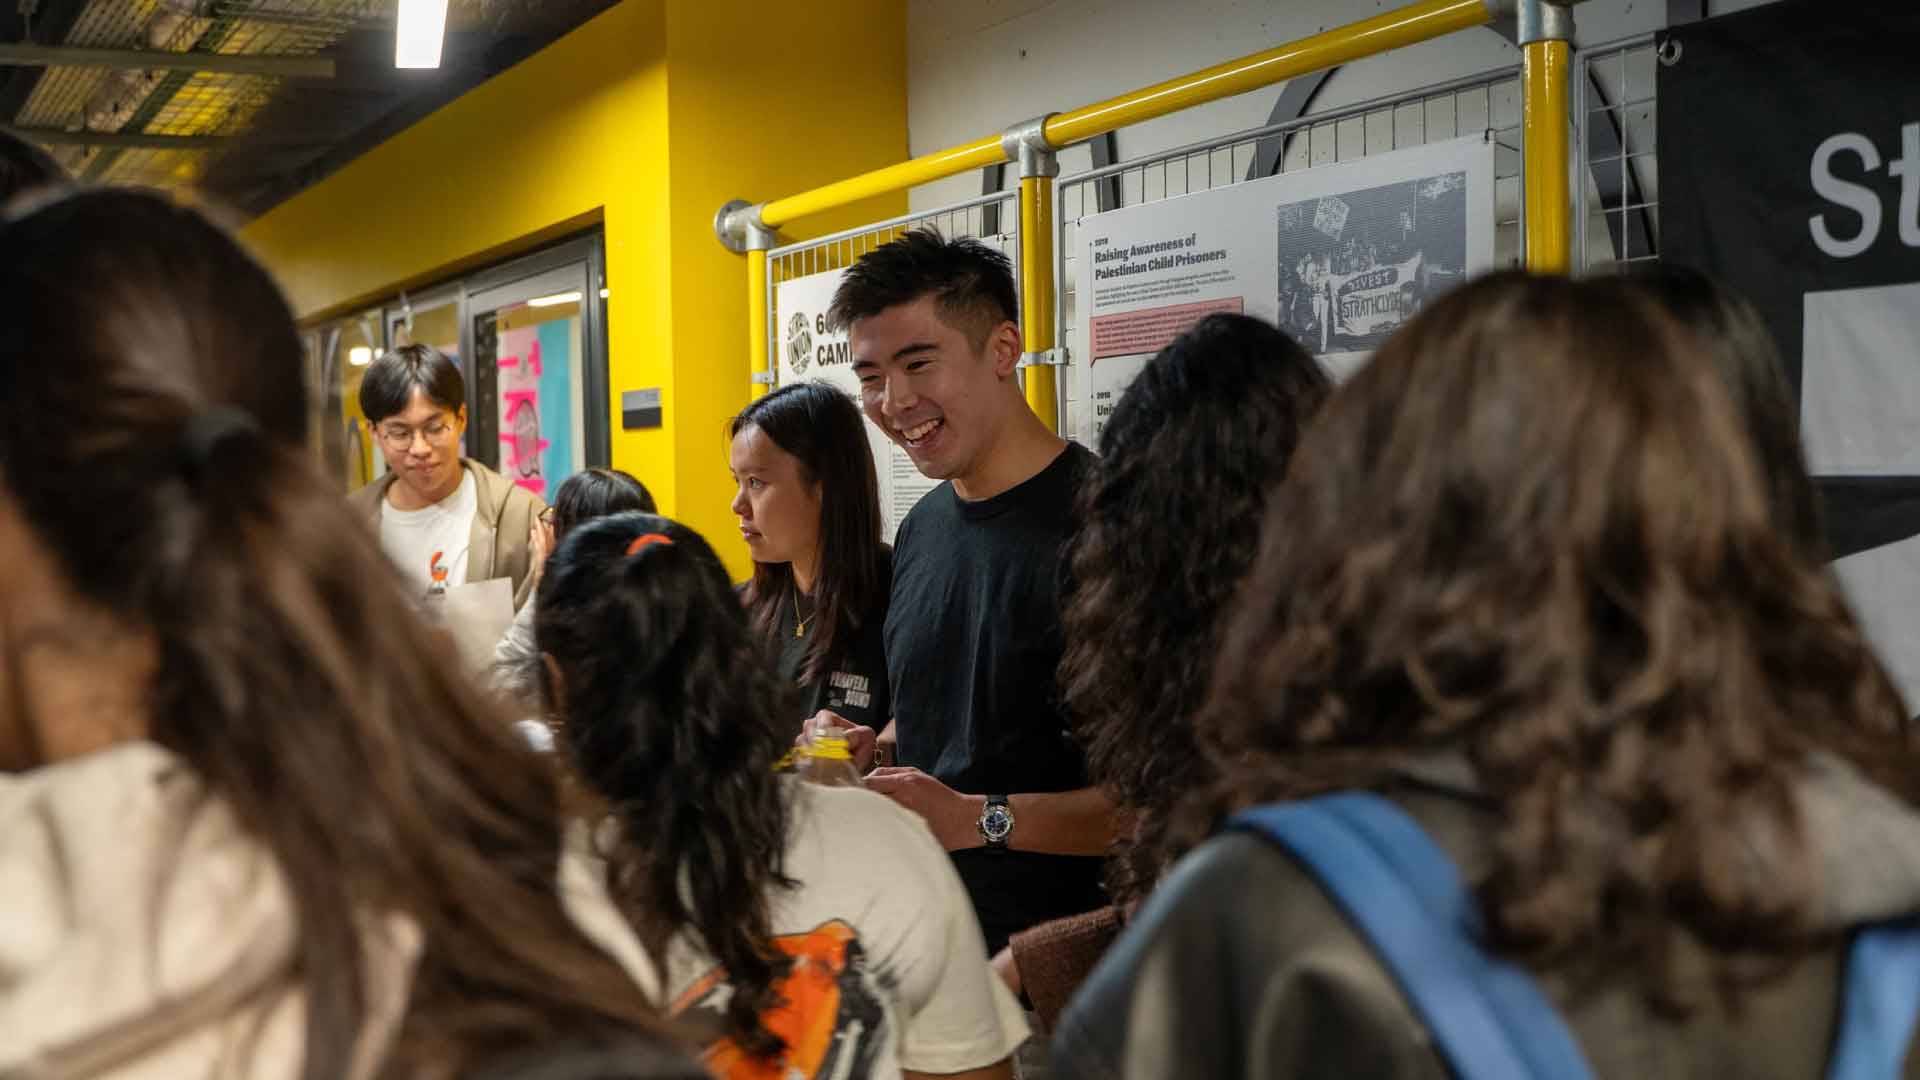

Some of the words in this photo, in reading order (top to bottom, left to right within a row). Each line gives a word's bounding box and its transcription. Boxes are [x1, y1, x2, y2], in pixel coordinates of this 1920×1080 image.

[1095, 247, 1129, 263] Raising
[1130, 238, 1184, 257] Awareness
[1185, 233, 1197, 246] of
[1095, 262, 1147, 280] Palestinian
[1148, 255, 1174, 271] Child
[1175, 249, 1227, 266] Prisoners
